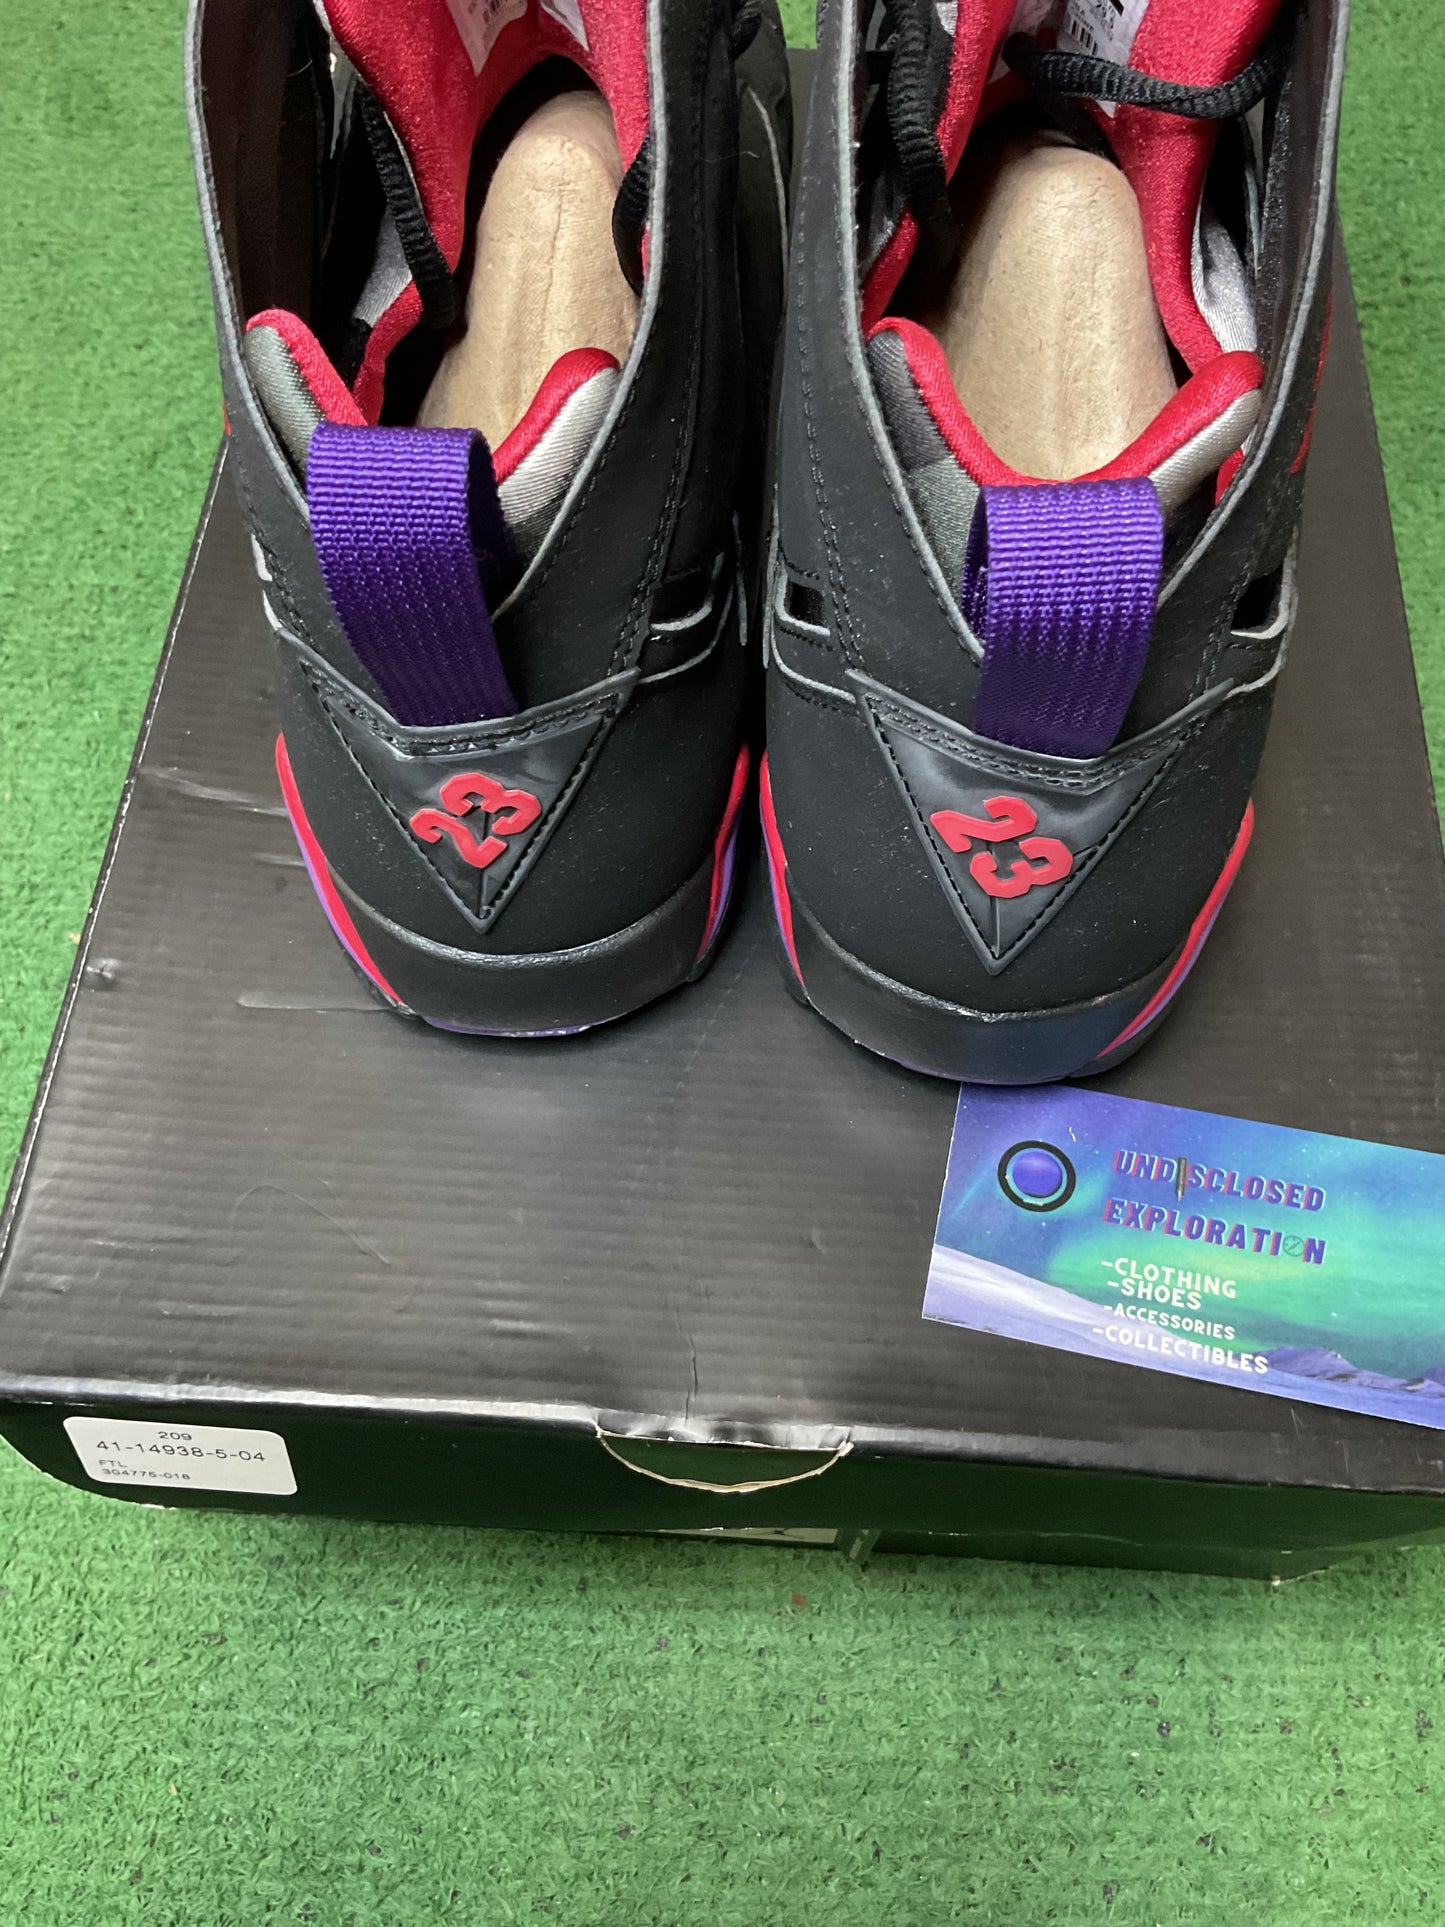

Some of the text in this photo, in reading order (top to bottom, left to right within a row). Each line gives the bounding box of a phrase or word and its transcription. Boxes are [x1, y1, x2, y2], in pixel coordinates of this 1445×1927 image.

[410, 772, 541, 868] 23
[930, 796, 1073, 898] 23
[1112, 1148, 1326, 1212] UNDISCLOSED
[1101, 1257, 1236, 1298] -CLOTHING
[1106, 1279, 1202, 1310] -SHOES
[1104, 1303, 1236, 1341] -ACCESSORIES
[1093, 1326, 1269, 1375] -COLLECTIBLES
[96, 1440, 266, 1462] 41-14938-5-04
[158, 1431, 192, 1441] 209
[98, 1460, 129, 1469] FTL
